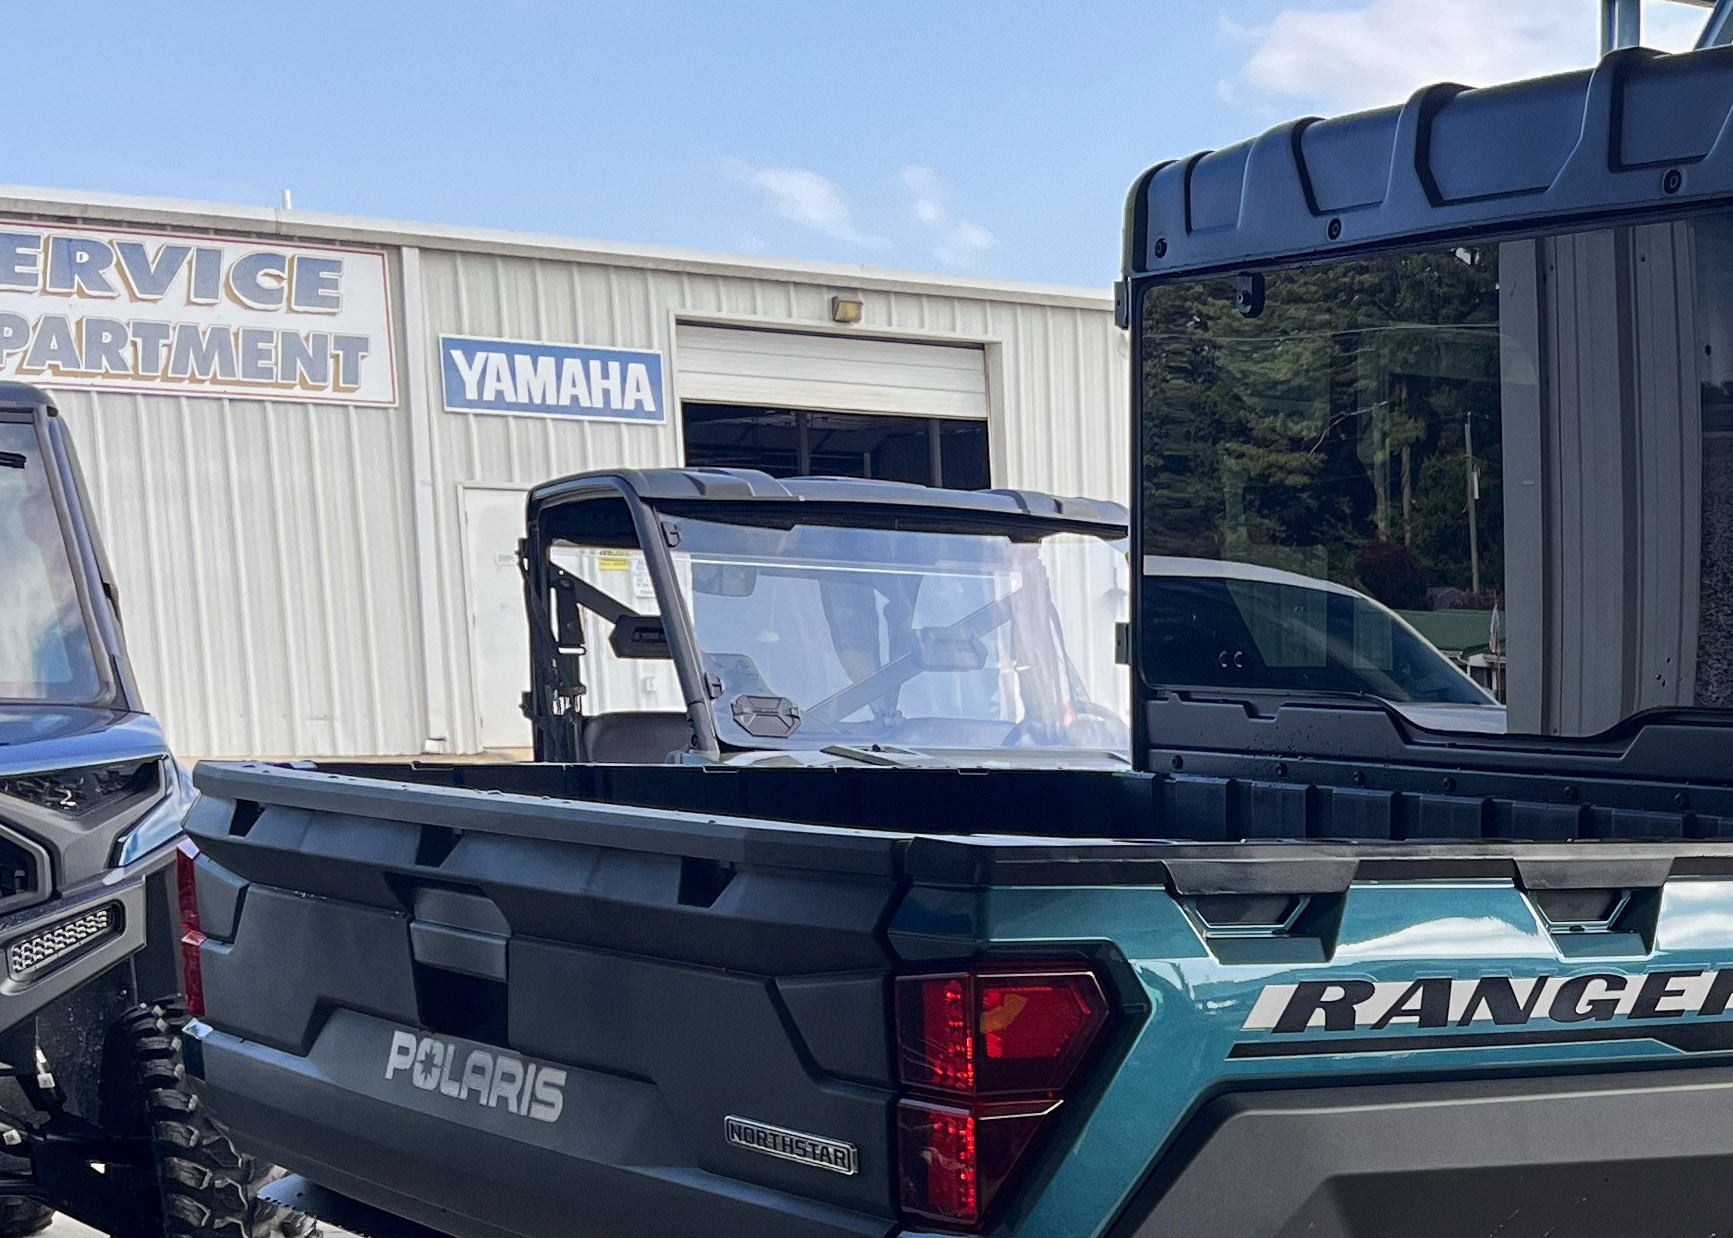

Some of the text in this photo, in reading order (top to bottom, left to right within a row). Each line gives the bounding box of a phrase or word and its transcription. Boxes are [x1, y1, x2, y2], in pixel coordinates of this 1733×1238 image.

[0, 231, 345, 315] ERVICE
[0, 311, 370, 390] PARTMENT
[450, 349, 656, 412] YAMAHA
[385, 1029, 567, 1123] POLARIS
[730, 1122, 848, 1169] NORTHSTAR
